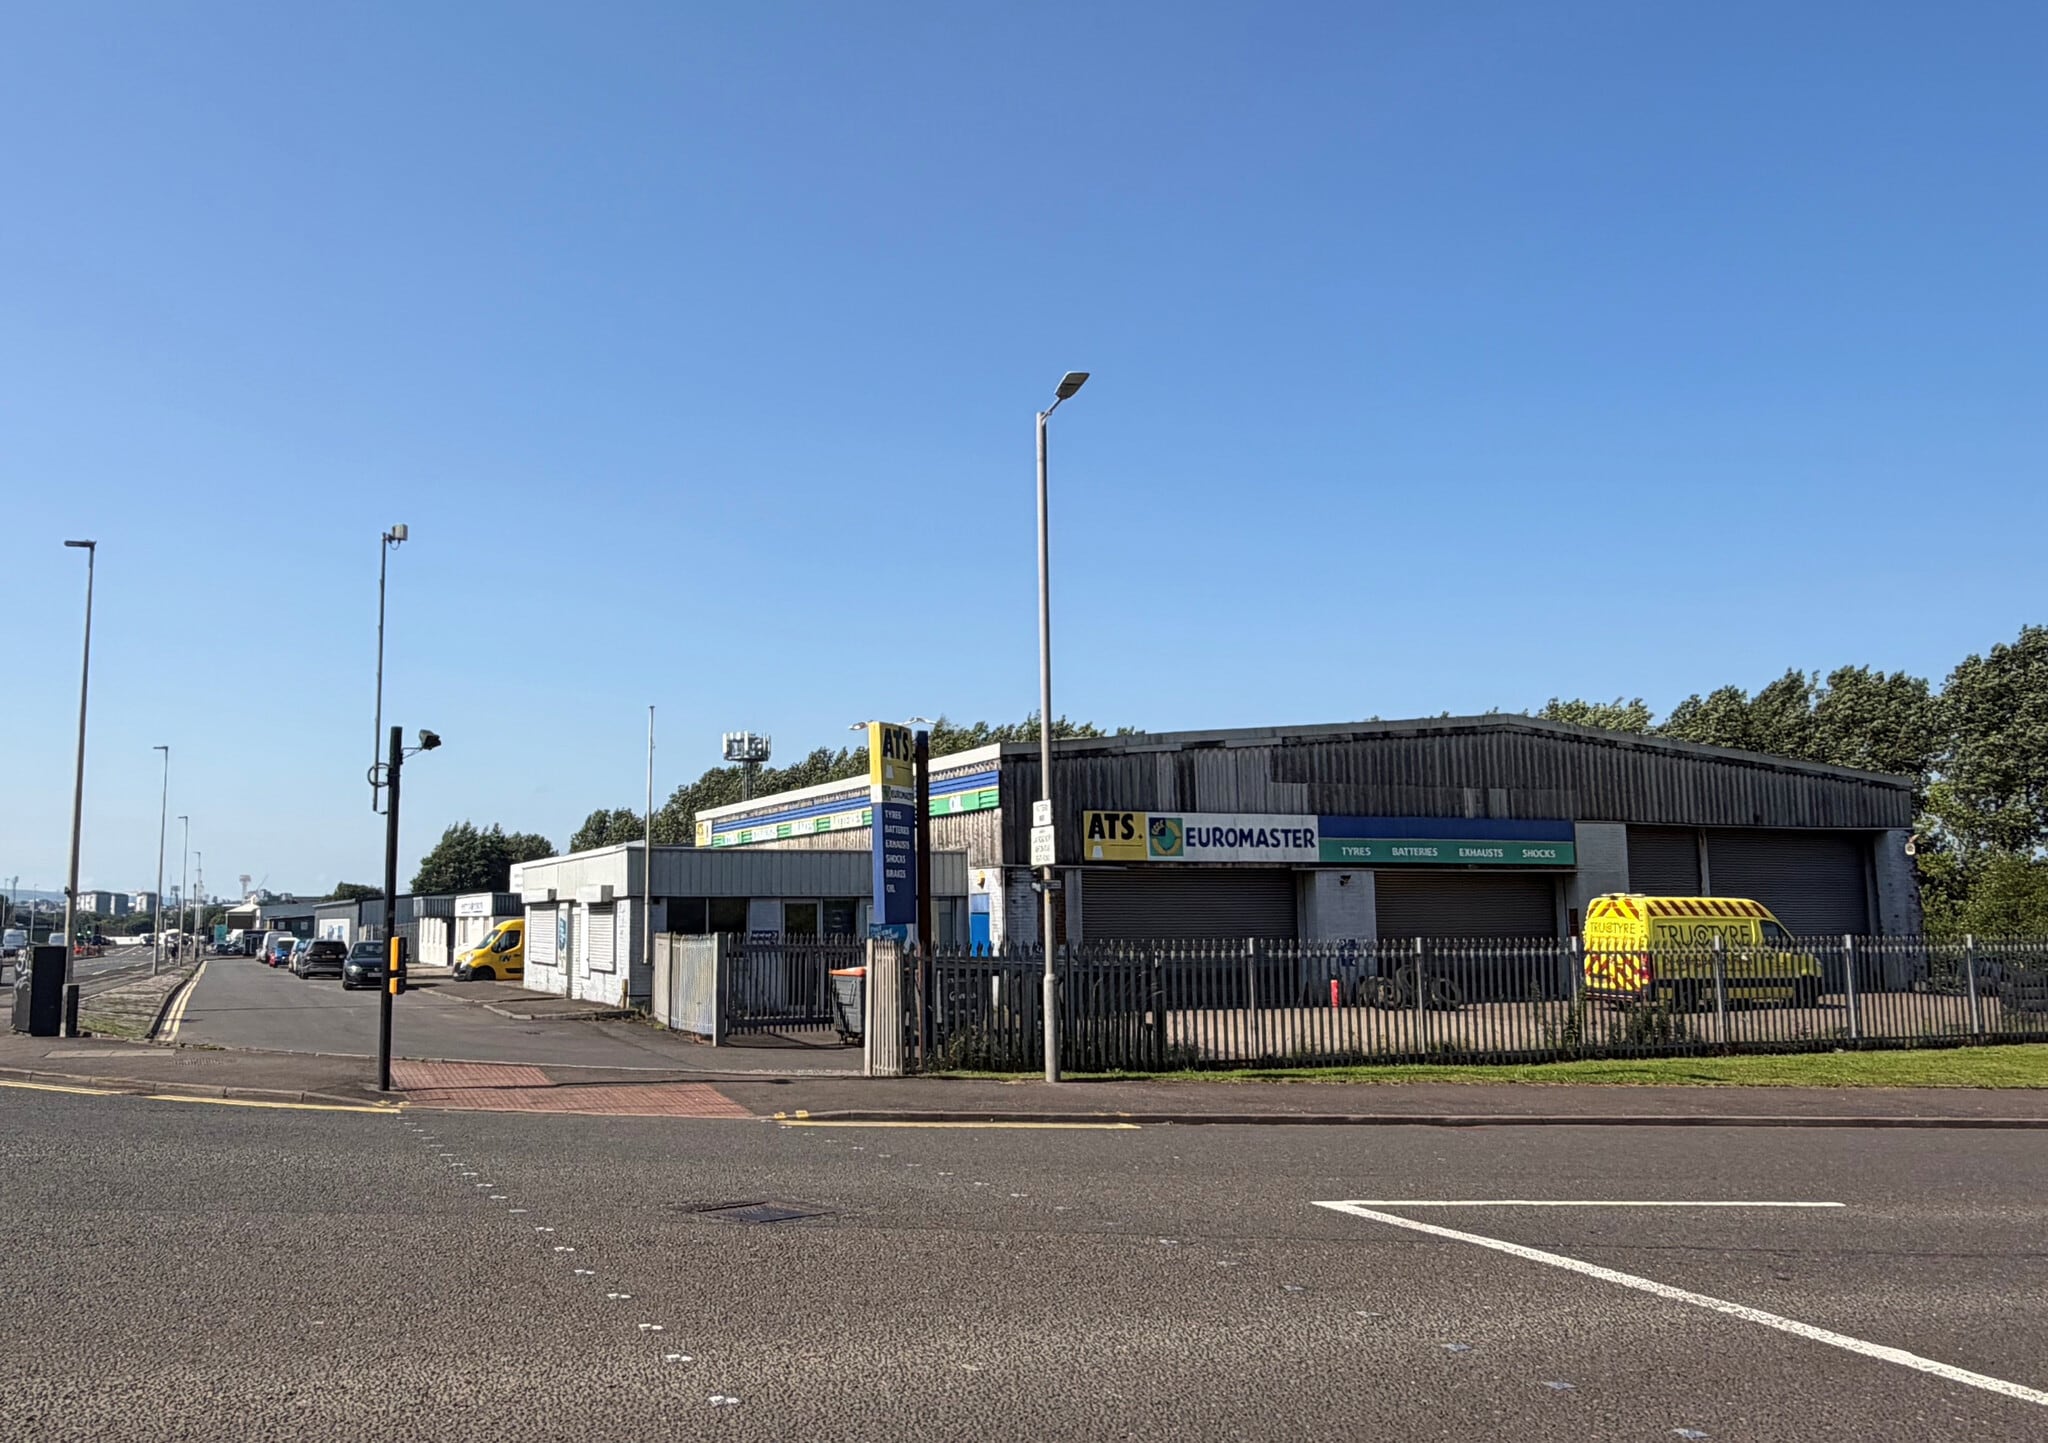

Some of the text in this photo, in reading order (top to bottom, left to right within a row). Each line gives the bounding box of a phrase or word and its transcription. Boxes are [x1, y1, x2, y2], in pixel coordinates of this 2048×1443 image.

[885, 810, 902, 820] TYRES
[1185, 827, 1315, 848] EUROMASTER
[1341, 846, 1556, 860] TYRES BATTERIES EXHAUSTS SHOCKS
[886, 855, 906, 864] SHOCKS
[886, 869, 906, 878] BRAKES
[886, 885, 896, 893] OIL
